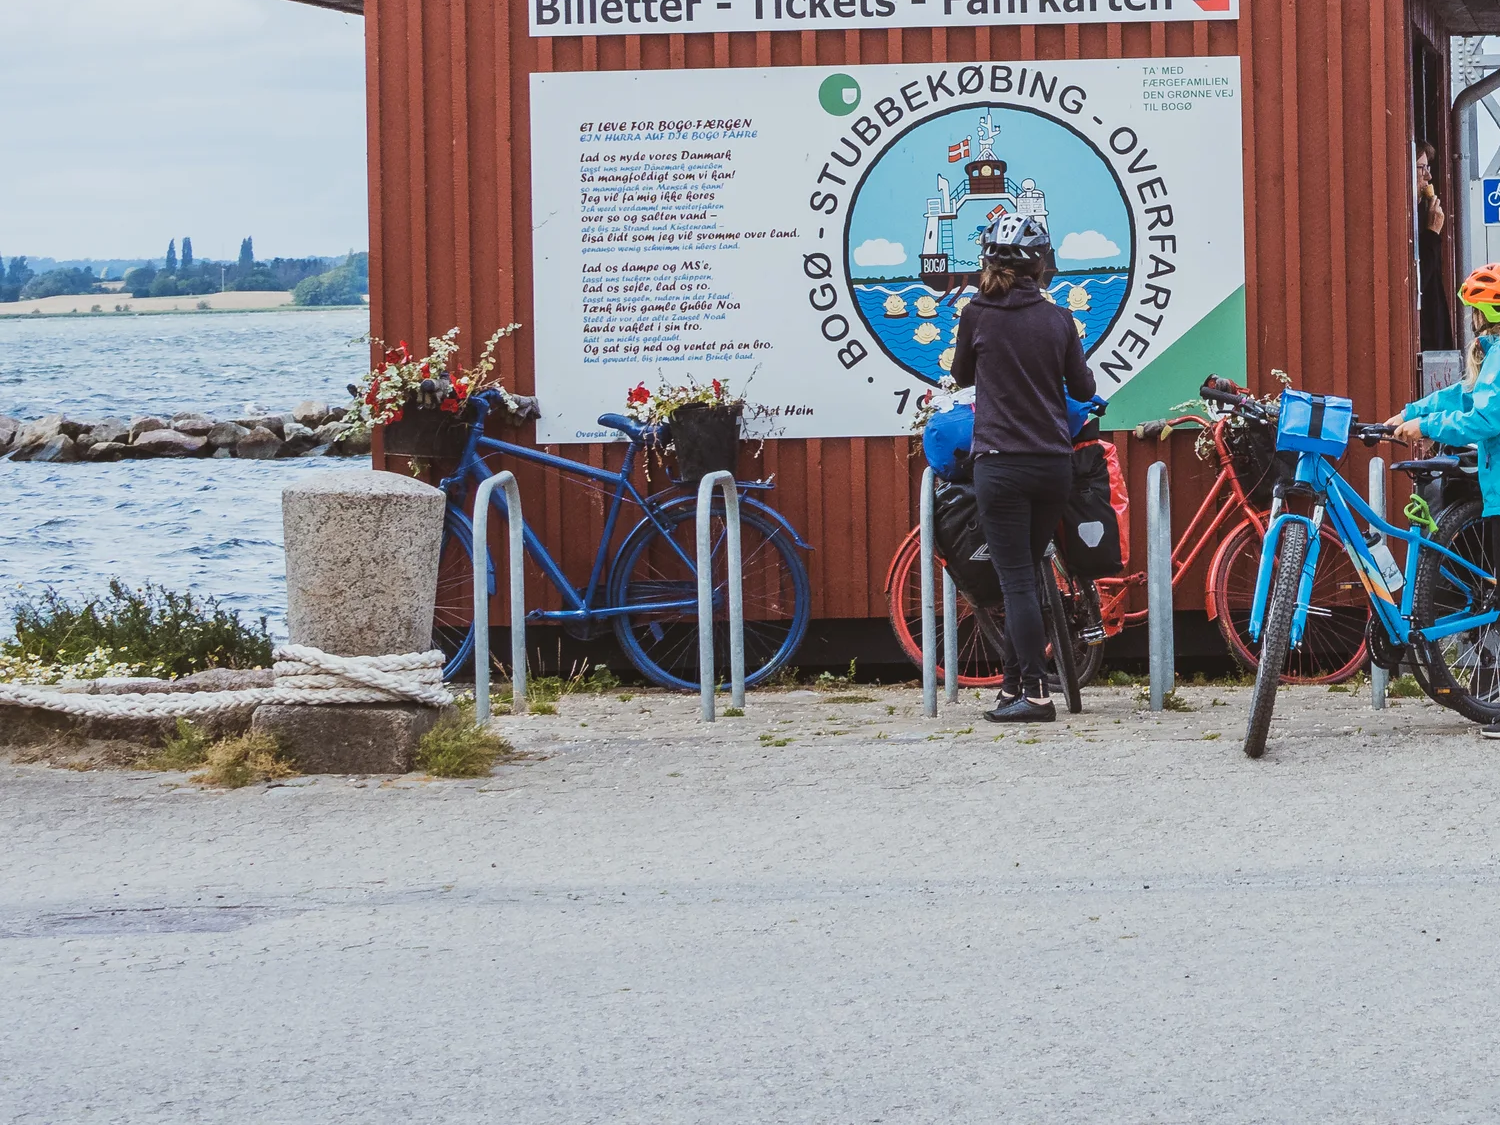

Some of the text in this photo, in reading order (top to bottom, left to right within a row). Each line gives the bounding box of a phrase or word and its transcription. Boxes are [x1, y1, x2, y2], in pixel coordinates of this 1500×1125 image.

[1161, 66, 1184, 75] MED
[1142, 77, 1229, 87] FÆRGEFAMILIEN
[1143, 89, 1234, 99] DEN GRØNNE VEJ
[1143, 102, 1192, 111] TIL BOGØ
[580, 122, 594, 132] ET
[598, 121, 627, 132] LEVE
[631, 121, 654, 131] FOR
[605, 133, 641, 142] HURRA
[645, 132, 665, 141] AUF
[810, 65, 1087, 215] STUBBEKØBING
[580, 148, 732, 164] Lad os nyde vores Danmark
[598, 171, 669, 185] mangfoldigt
[672, 173, 695, 181] som
[699, 170, 708, 180] vi
[711, 169, 736, 182] kan!
[642, 183, 653, 191] ein
[657, 182, 688, 192] Mensch
[701, 181, 724, 192] kann!
[580, 191, 600, 204] Jeg
[604, 191, 618, 201] vil
[660, 190, 682, 203] ikke
[580, 204, 595, 212] Ich
[661, 203, 673, 211] nie
[623, 214, 638, 224] og
[641, 210, 677, 222] salten
[680, 210, 707, 220] vand
[581, 225, 595, 234] als
[623, 223, 649, 232] Strand
[652, 223, 667, 231] und
[607, 232, 628, 242] lidt
[632, 234, 655, 242] som
[658, 231, 675, 243] jeg
[678, 230, 693, 240] vil
[770, 228, 800, 238] land.
[618, 244, 641, 254] wenig
[682, 243, 693, 251] ich
[1100, 126, 1177, 384] OVERFARTEN
[582, 263, 602, 273] Lad
[605, 265, 618, 273] os
[622, 261, 659, 275] dampe
[663, 264, 677, 274] og
[923, 258, 946, 274] BOGØ
[653, 273, 672, 281] oder
[582, 283, 603, 293] lad
[607, 285, 620, 293] os
[623, 281, 653, 295] sejle,
[656, 281, 676, 291] lad
[680, 283, 693, 291] os
[683, 293, 690, 301] in
[693, 293, 705, 301] der
[582, 300, 741, 316] Tænk hvis gamle Gubbe Noa
[803, 253, 868, 370] BOGØ
[606, 315, 617, 323] dir
[637, 314, 650, 322] der
[703, 311, 726, 320] Noah
[583, 321, 702, 335] havde vaklet i sin tro.
[583, 343, 599, 356] Og
[602, 343, 620, 354] sat
[623, 342, 640, 355] sig
[643, 342, 662, 352] ned
[666, 344, 680, 354] og
[684, 340, 716, 351] ventet
[720, 341, 734, 353] på
[753, 339, 774, 349] bro.
[584, 354, 600, 363] Und
[642, 354, 653, 363] bis
[655, 353, 685, 364] jemand
[687, 353, 703, 361] eine
[784, 404, 814, 416] Hein
[575, 430, 607, 438] Oversat
